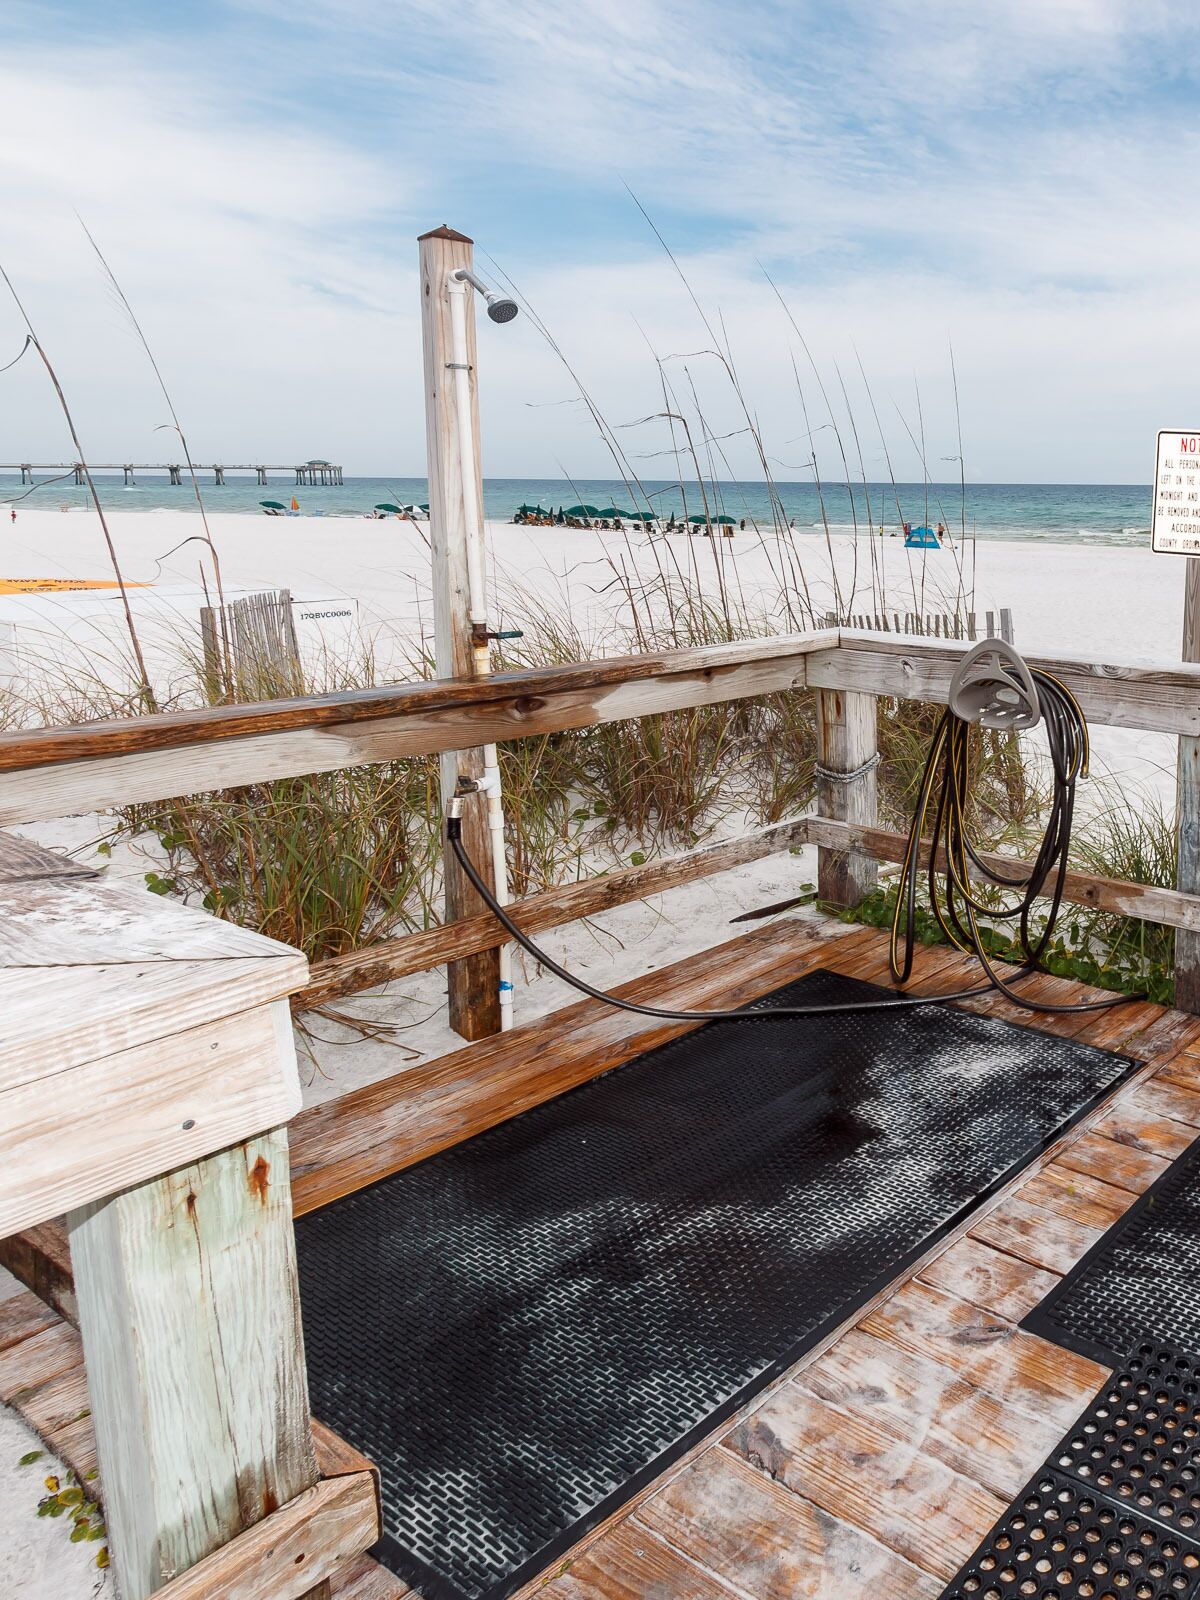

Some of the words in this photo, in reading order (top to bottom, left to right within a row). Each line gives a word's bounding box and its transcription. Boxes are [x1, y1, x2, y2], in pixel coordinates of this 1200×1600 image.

[1164, 459, 1174, 469] ALL
[1160, 474, 1171, 485] LEFT
[1176, 475, 1182, 485] ON
[1186, 475, 1195, 486] THE
[1159, 491, 1183, 501] MIDNIGHT
[1188, 492, 1198, 502] AND
[1157, 506, 1164, 516] BE
[1167, 506, 1190, 517] REMOVED
[1159, 537, 1178, 548] COUNTY
[300, 610, 352, 620] 17QBVC0006
